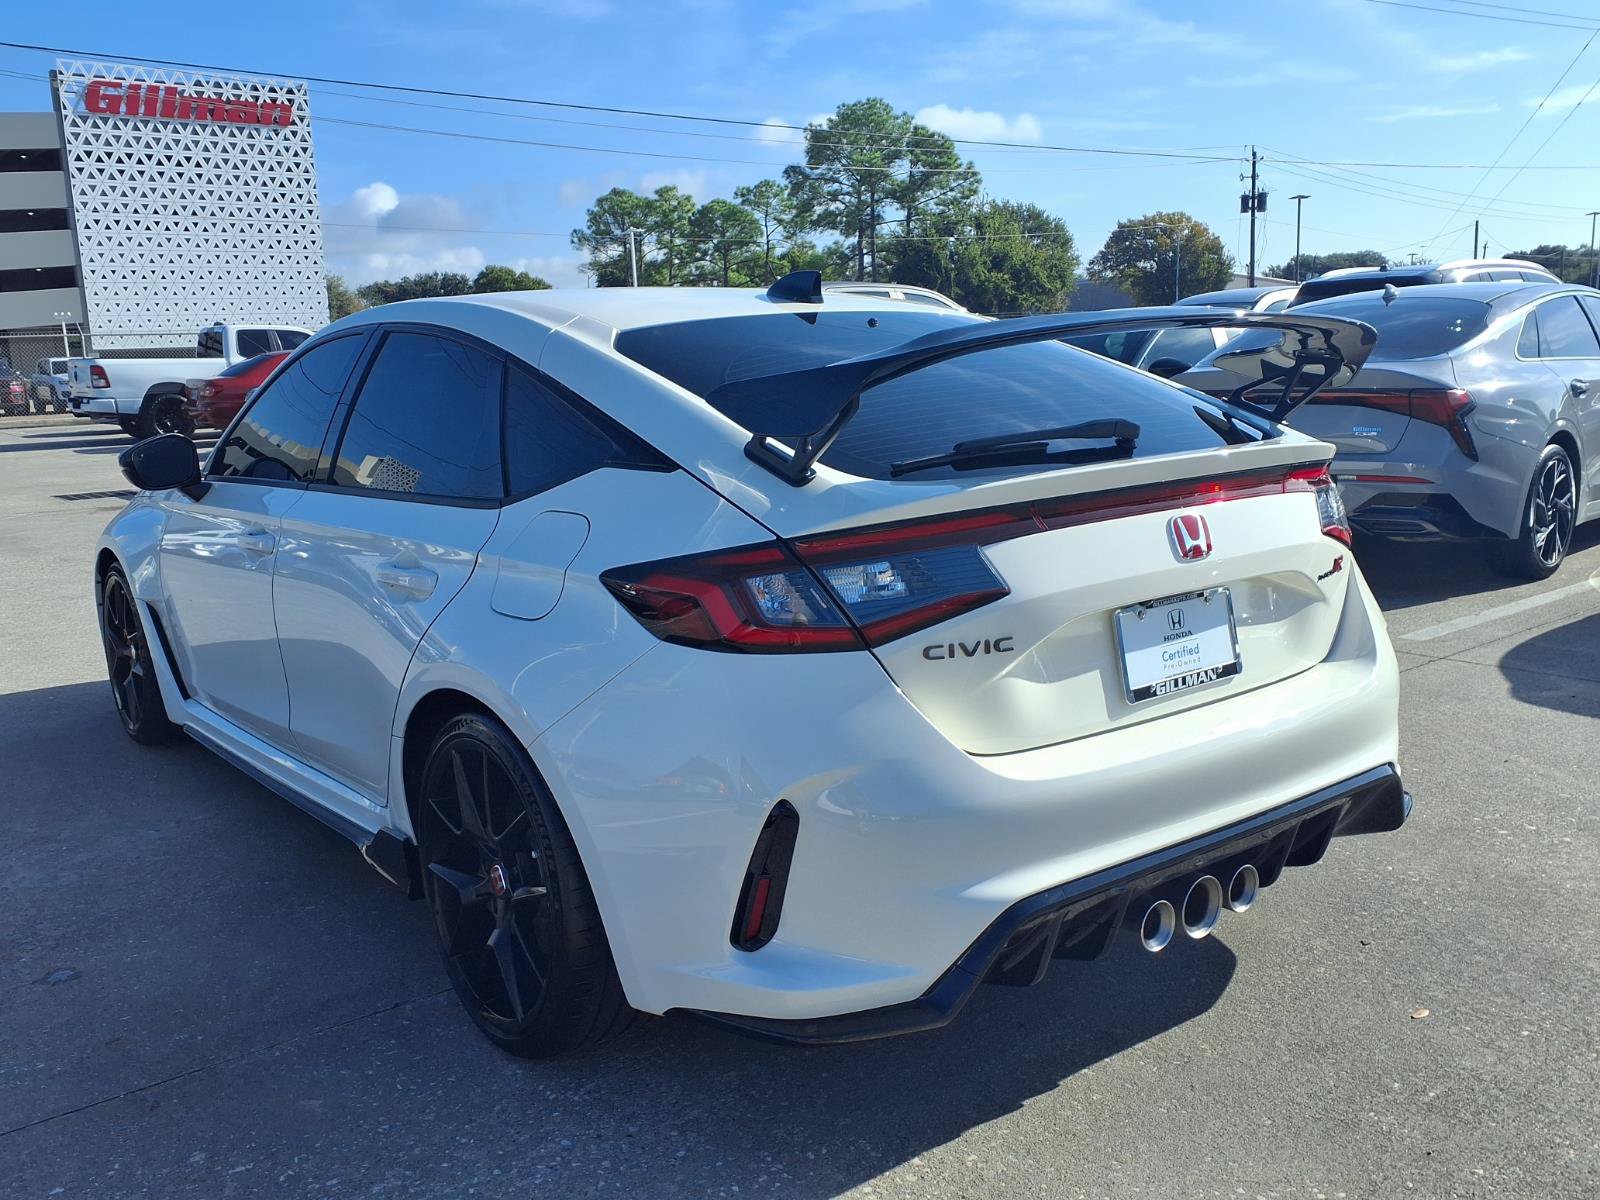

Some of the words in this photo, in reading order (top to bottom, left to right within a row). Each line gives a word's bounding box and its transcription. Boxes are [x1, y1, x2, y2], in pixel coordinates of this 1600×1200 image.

[84, 80, 292, 127] Gillman
[922, 636, 1014, 660] CIVIC
[1163, 630, 1193, 642] HONDA
[1161, 643, 1200, 662] Certified
[1156, 668, 1217, 695] GILLMAN
